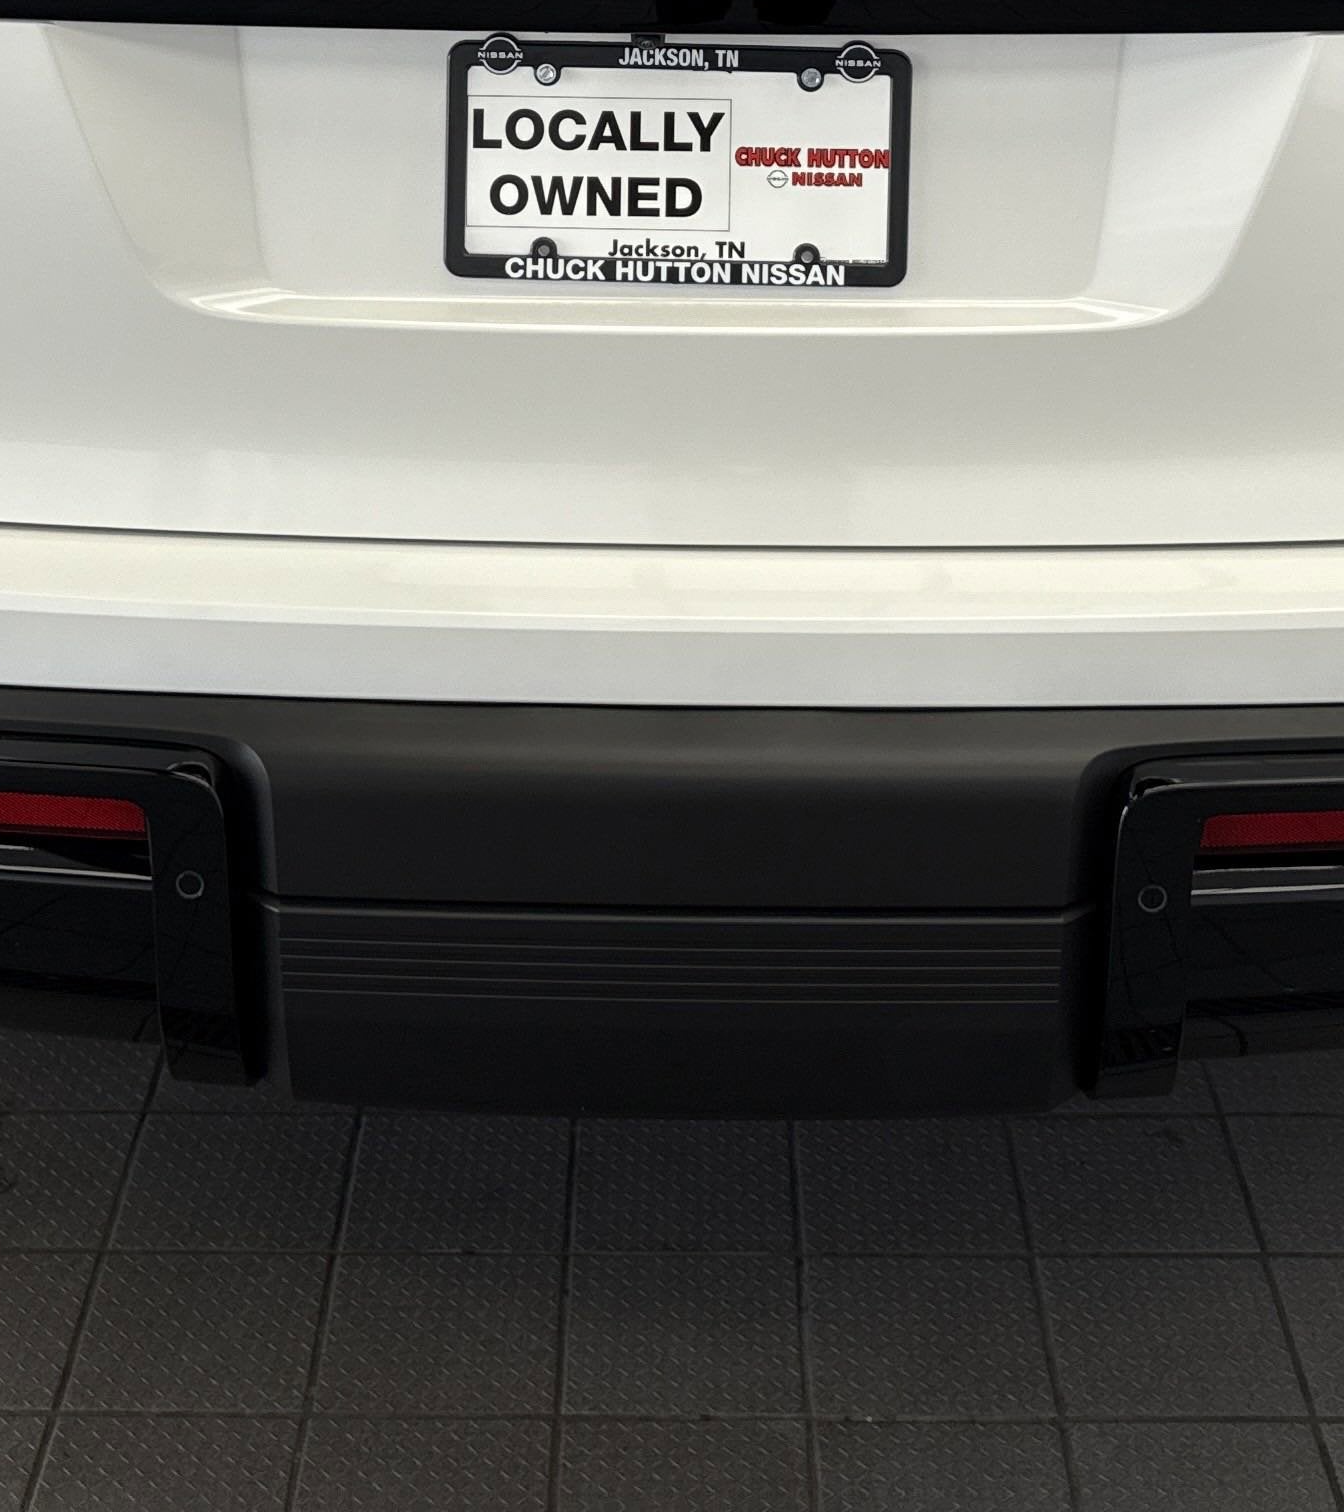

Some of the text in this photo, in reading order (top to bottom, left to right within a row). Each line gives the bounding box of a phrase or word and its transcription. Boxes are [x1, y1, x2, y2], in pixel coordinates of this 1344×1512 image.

[477, 50, 524, 60] NISSAN
[619, 47, 739, 70] JACKSON, TN
[835, 58, 881, 68] NISSAN
[471, 108, 725, 152] LOCALLY
[735, 146, 890, 169] CHUCK HUTTON
[791, 171, 863, 187] NISSAN
[489, 174, 703, 218] OWNED
[607, 238, 745, 260] Jackson, TN
[504, 257, 845, 286] CHUCK HUTTON NISSAN
